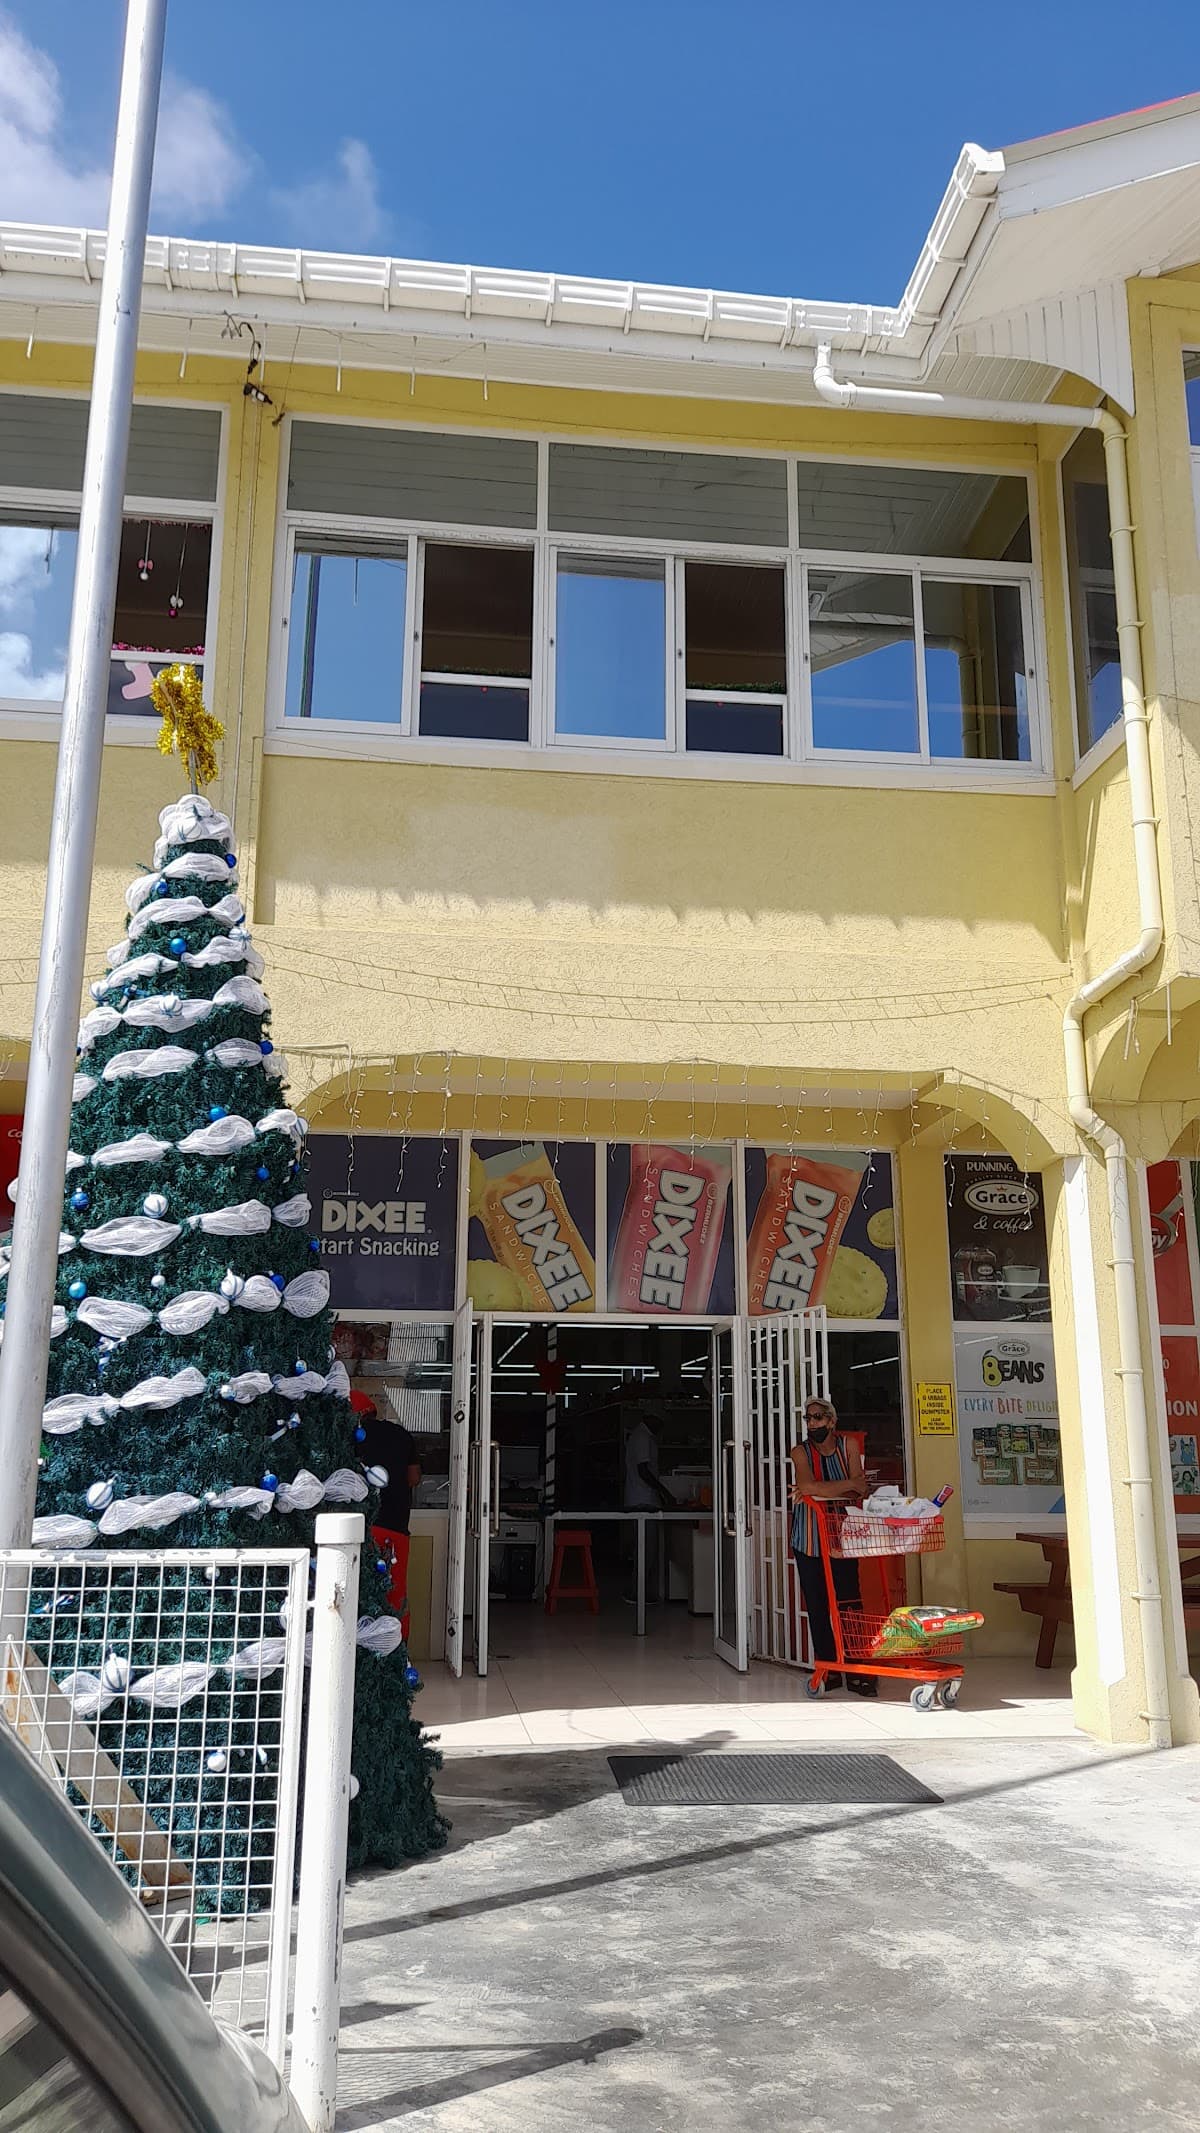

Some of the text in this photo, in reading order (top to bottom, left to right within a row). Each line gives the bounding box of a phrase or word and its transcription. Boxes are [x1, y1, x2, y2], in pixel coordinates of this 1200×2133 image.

[966, 1161, 1014, 1172] RUNNING
[976, 1190, 1029, 1204] Grace
[321, 1199, 427, 1234] DIXEE
[973, 1216, 1033, 1233] & coffee
[320, 1237, 440, 1257] tart Snacking
[489, 1201, 552, 1311] SANDWICHE
[501, 1183, 593, 1312] DIXEE
[640, 1169, 706, 1311] DIXEE
[762, 1179, 838, 1312] DIXEE
[982, 1354, 1045, 1388] BEANS
[964, 1398, 994, 1412] EVERY
[997, 1397, 1023, 1415] BITE
